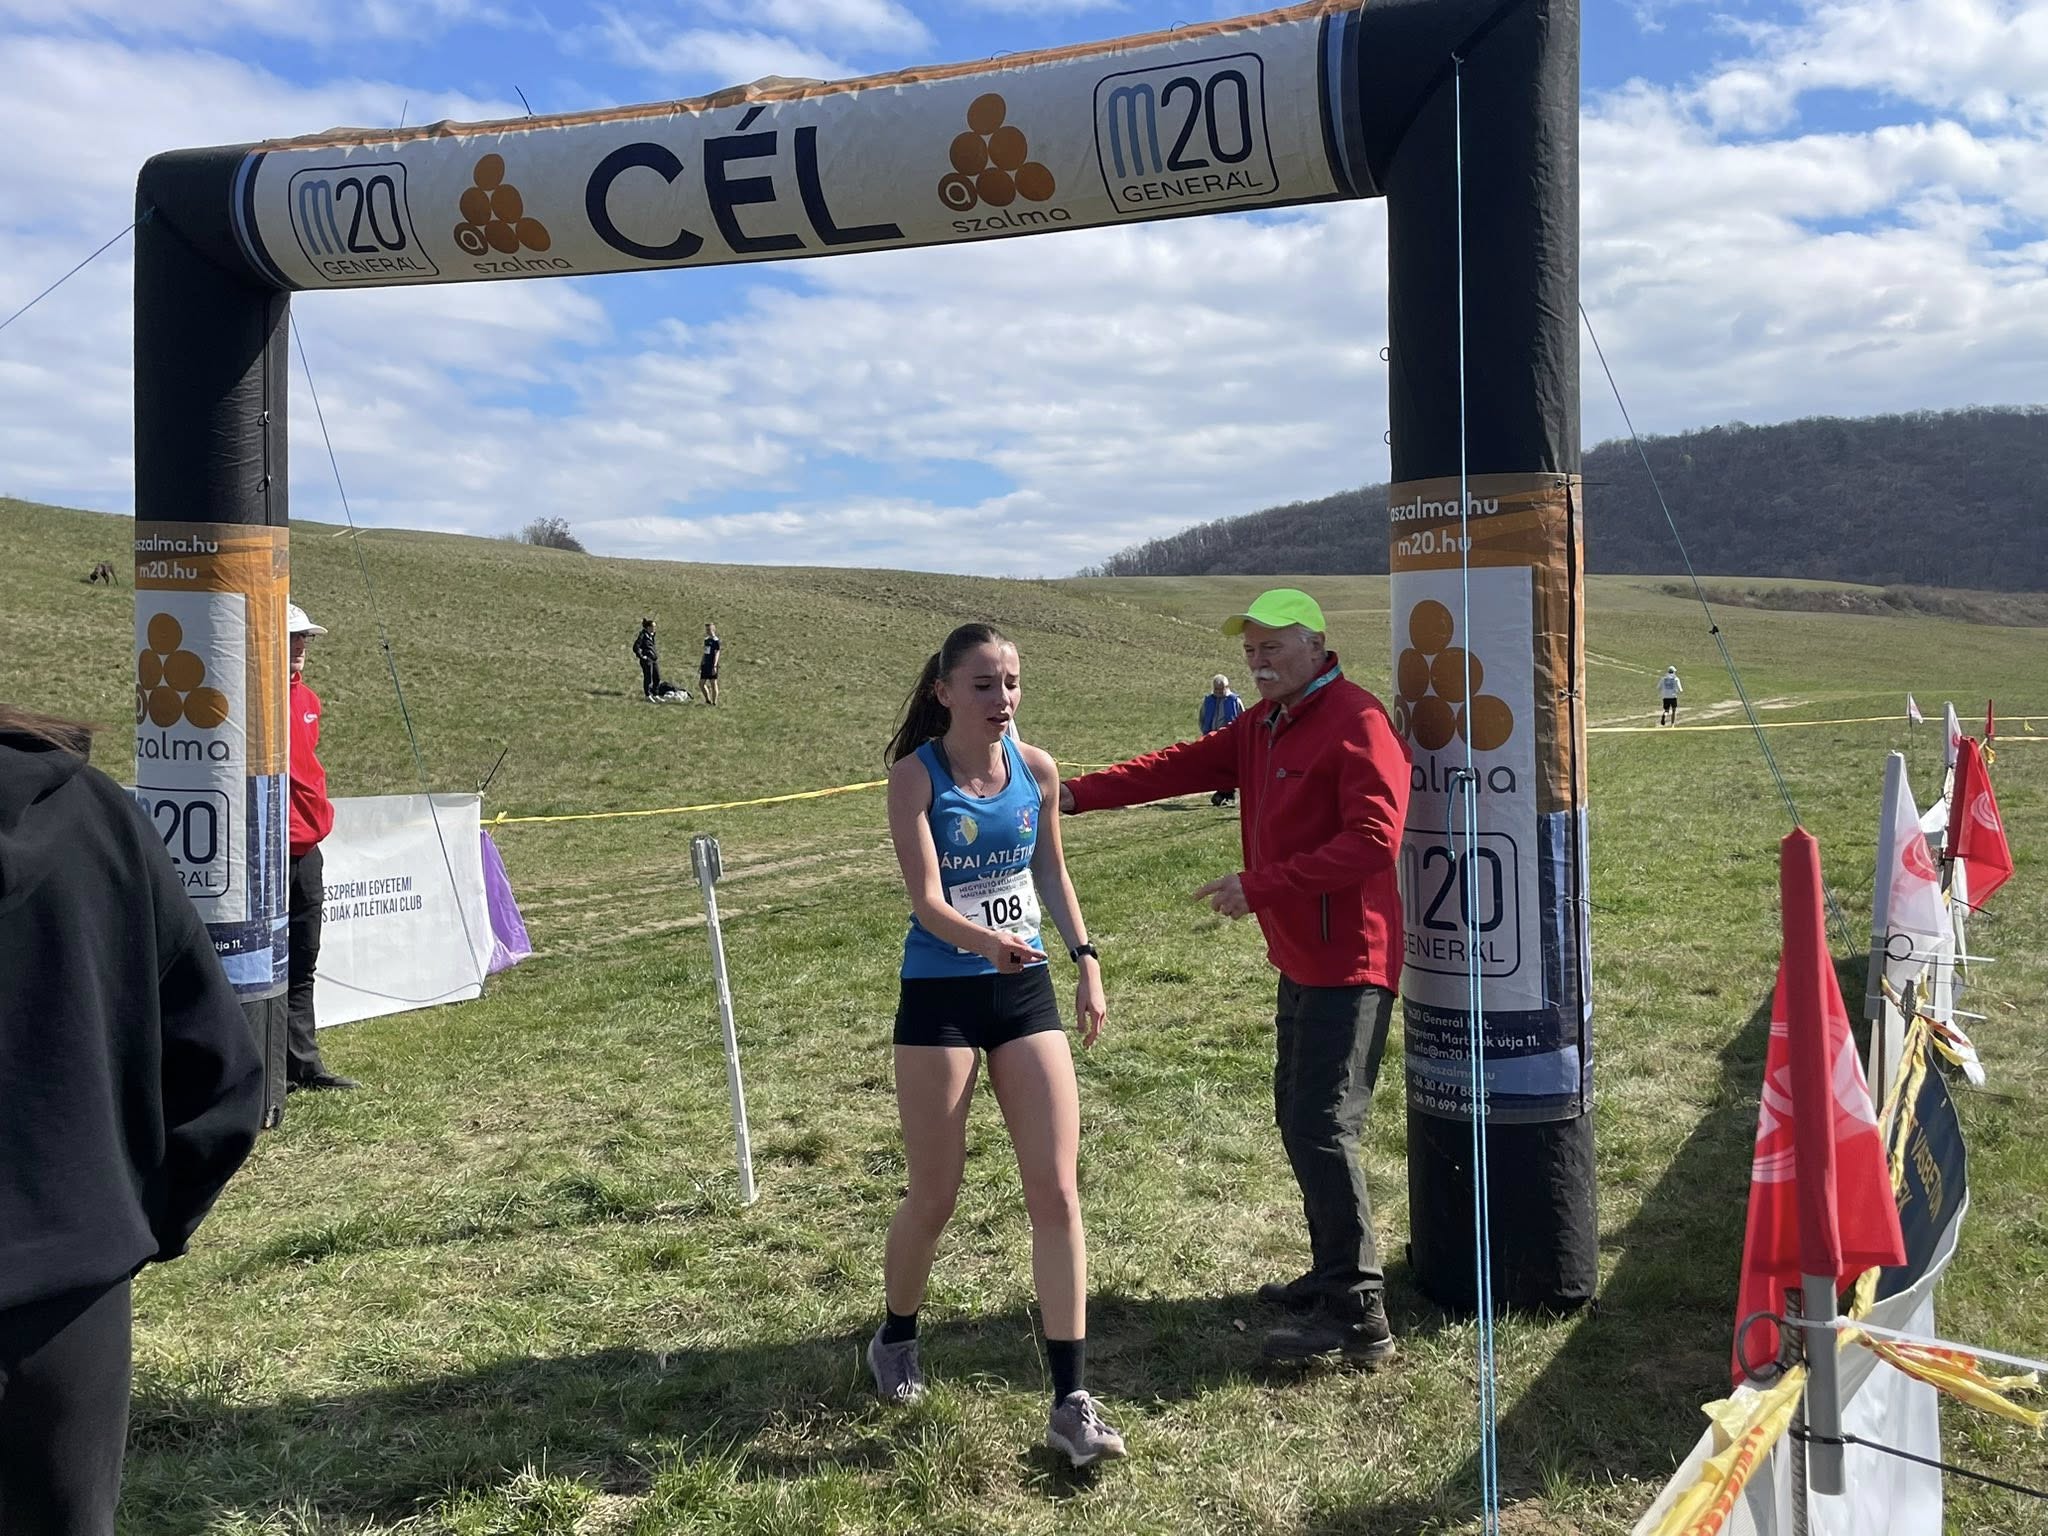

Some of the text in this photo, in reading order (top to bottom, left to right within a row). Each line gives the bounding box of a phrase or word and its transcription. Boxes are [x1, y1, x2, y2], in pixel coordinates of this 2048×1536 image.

[1107, 69, 1253, 179] m20
[585, 106, 905, 260] CÉL
[1121, 169, 1264, 202] GENERÁL
[300, 175, 406, 256] m20
[951, 204, 1072, 234] szalma
[322, 256, 427, 276] GENERÁL
[472, 256, 574, 275] szalma
[135, 533, 218, 553] szalma.hu
[1398, 529, 1472, 556] m20.hu
[139, 560, 198, 579] m20.hu
[136, 731, 230, 761] zalma
[141, 798, 217, 865] 20
[941, 851, 980, 869] ÁPAI
[323, 876, 412, 902] ESZPRÉMI EGYETEMI
[322, 894, 423, 923] S DIÁK ATLÉTIKAI CLUB
[981, 894, 1022, 927] 108
[215, 939, 244, 953] tja 11.
[1423, 1011, 1463, 1028] Generál
[1497, 1033, 1523, 1051] útja
[1526, 1035, 1540, 1047] 11.
[1438, 1081, 1456, 1095] 477
[1438, 1099, 1457, 1112] 699
